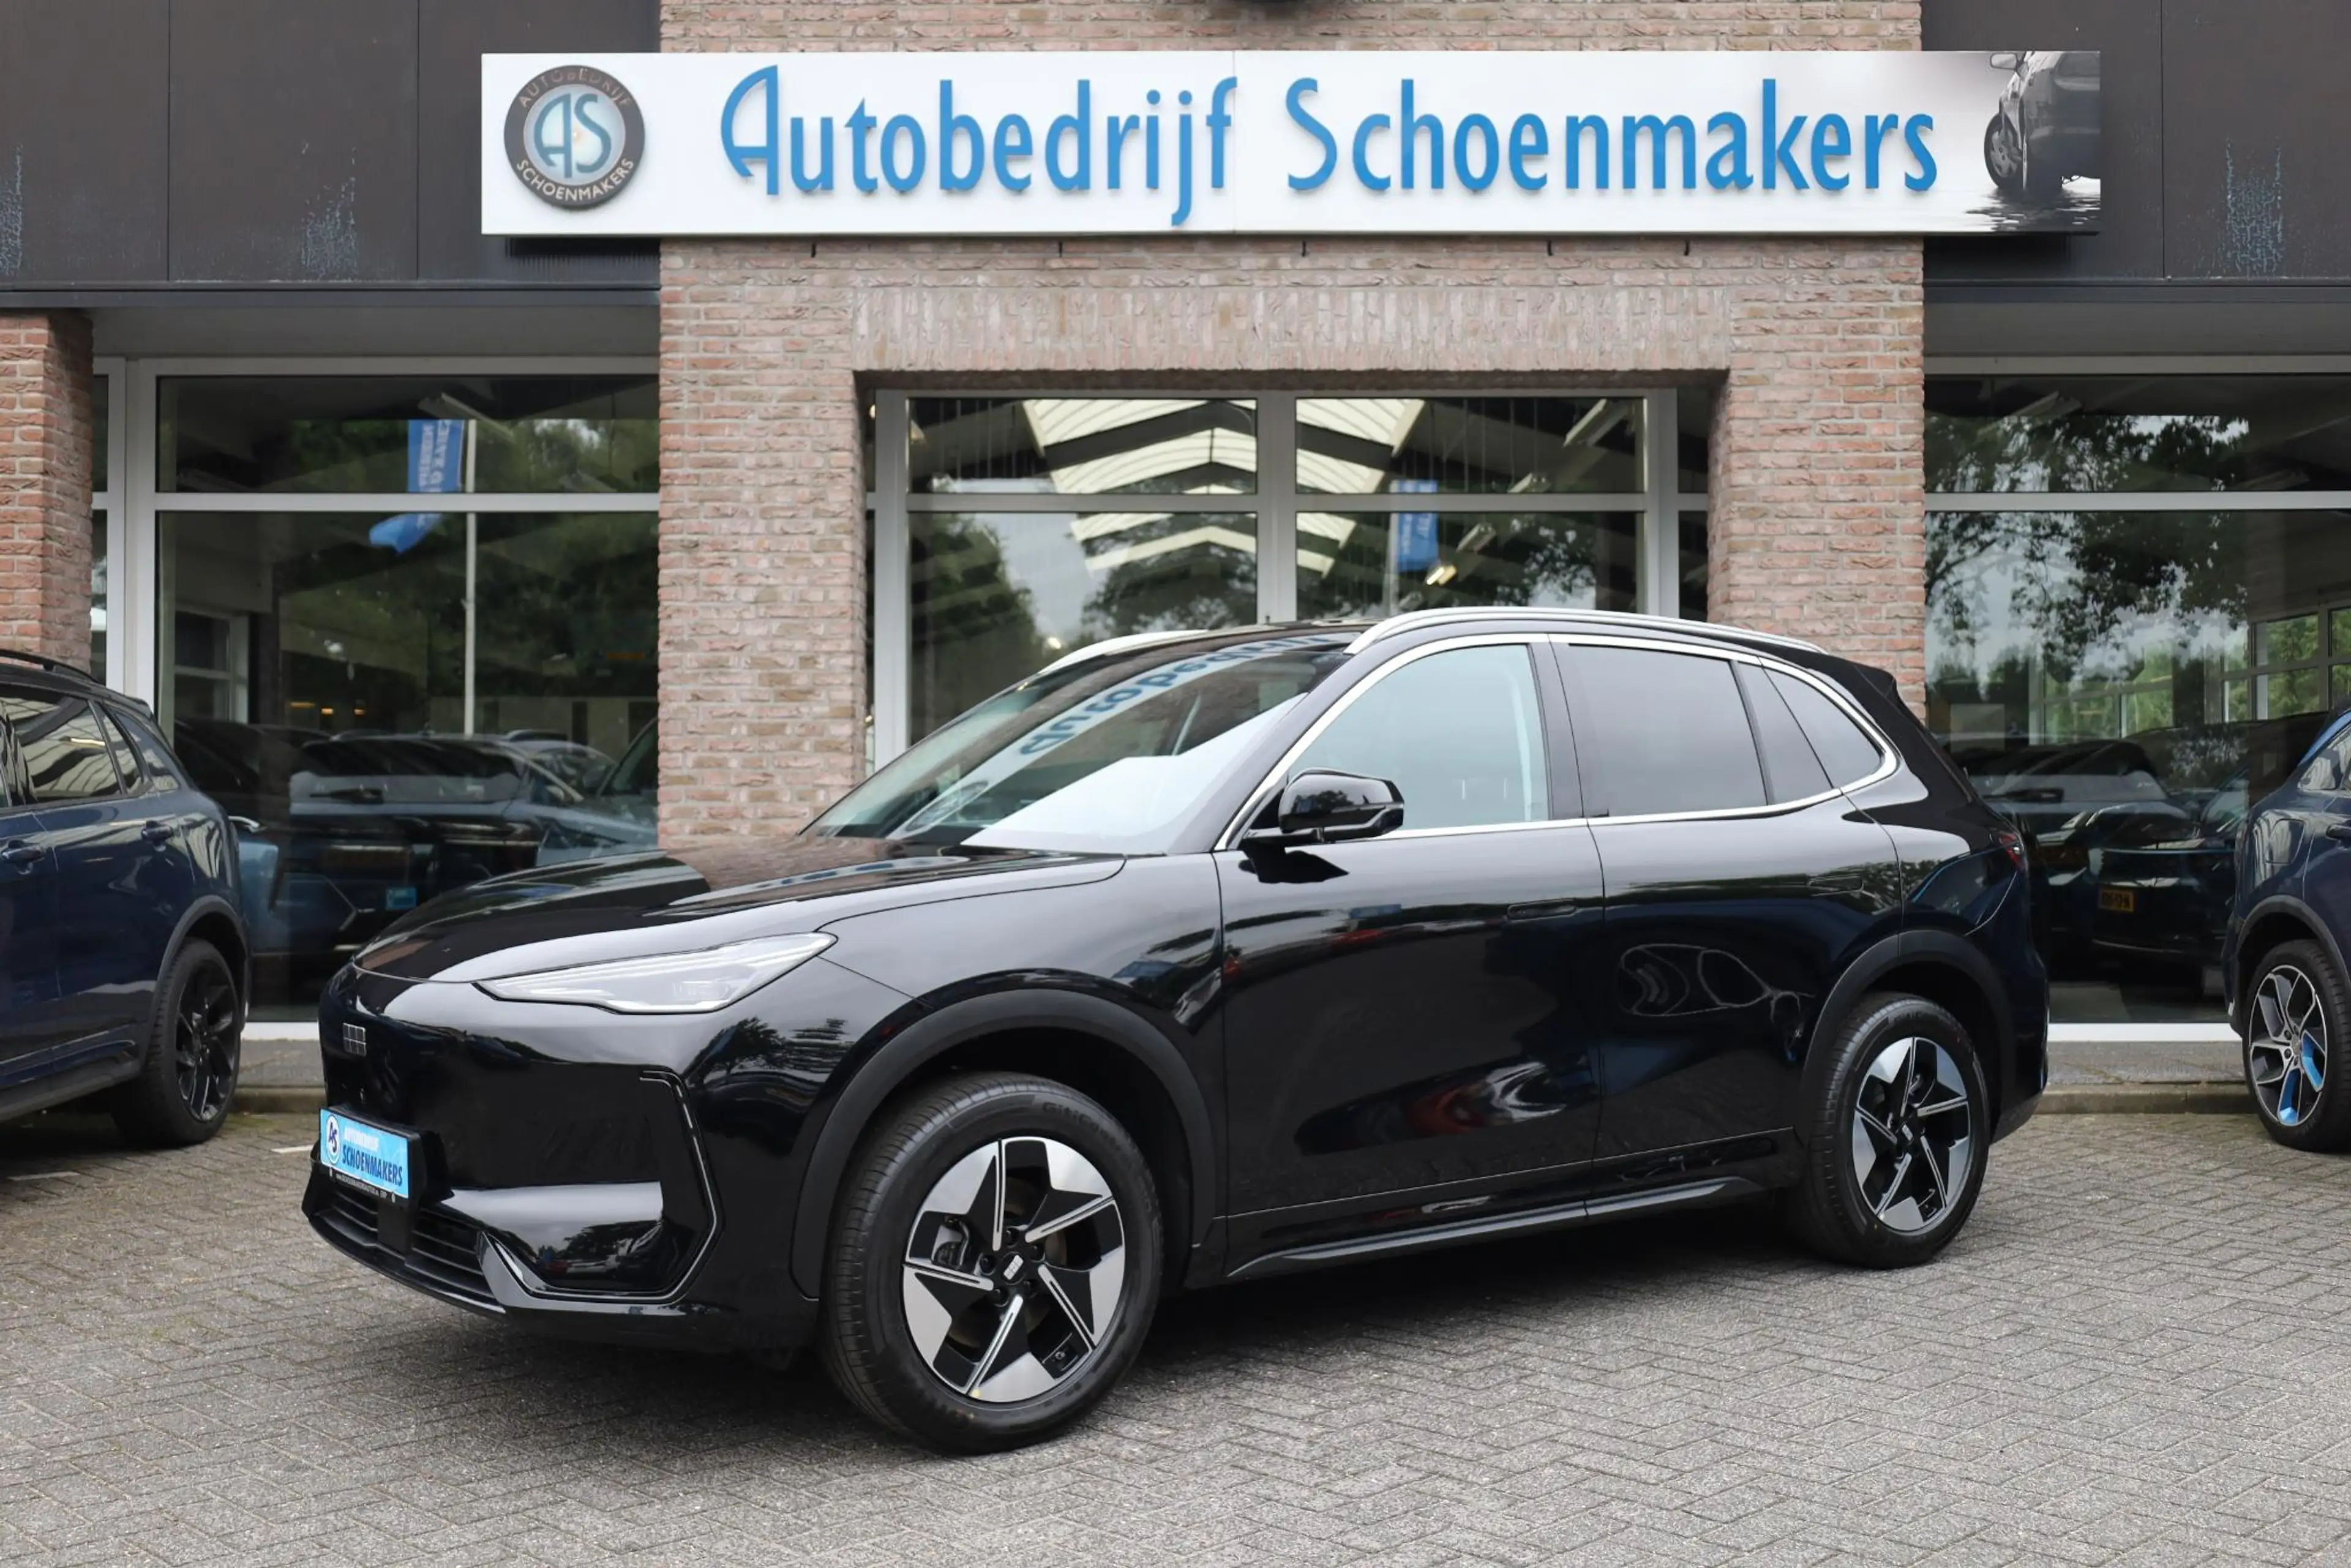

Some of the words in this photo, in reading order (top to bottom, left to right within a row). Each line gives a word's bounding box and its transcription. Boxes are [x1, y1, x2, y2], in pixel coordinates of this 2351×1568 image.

[533, 93, 612, 178] AS
[721, 64, 1238, 227] Autobedrijf
[1284, 77, 1938, 192] Schoenmakers
[516, 158, 634, 201] SCHOENMAKERS
[342, 1144, 403, 1187] SCHOENMAKERS
